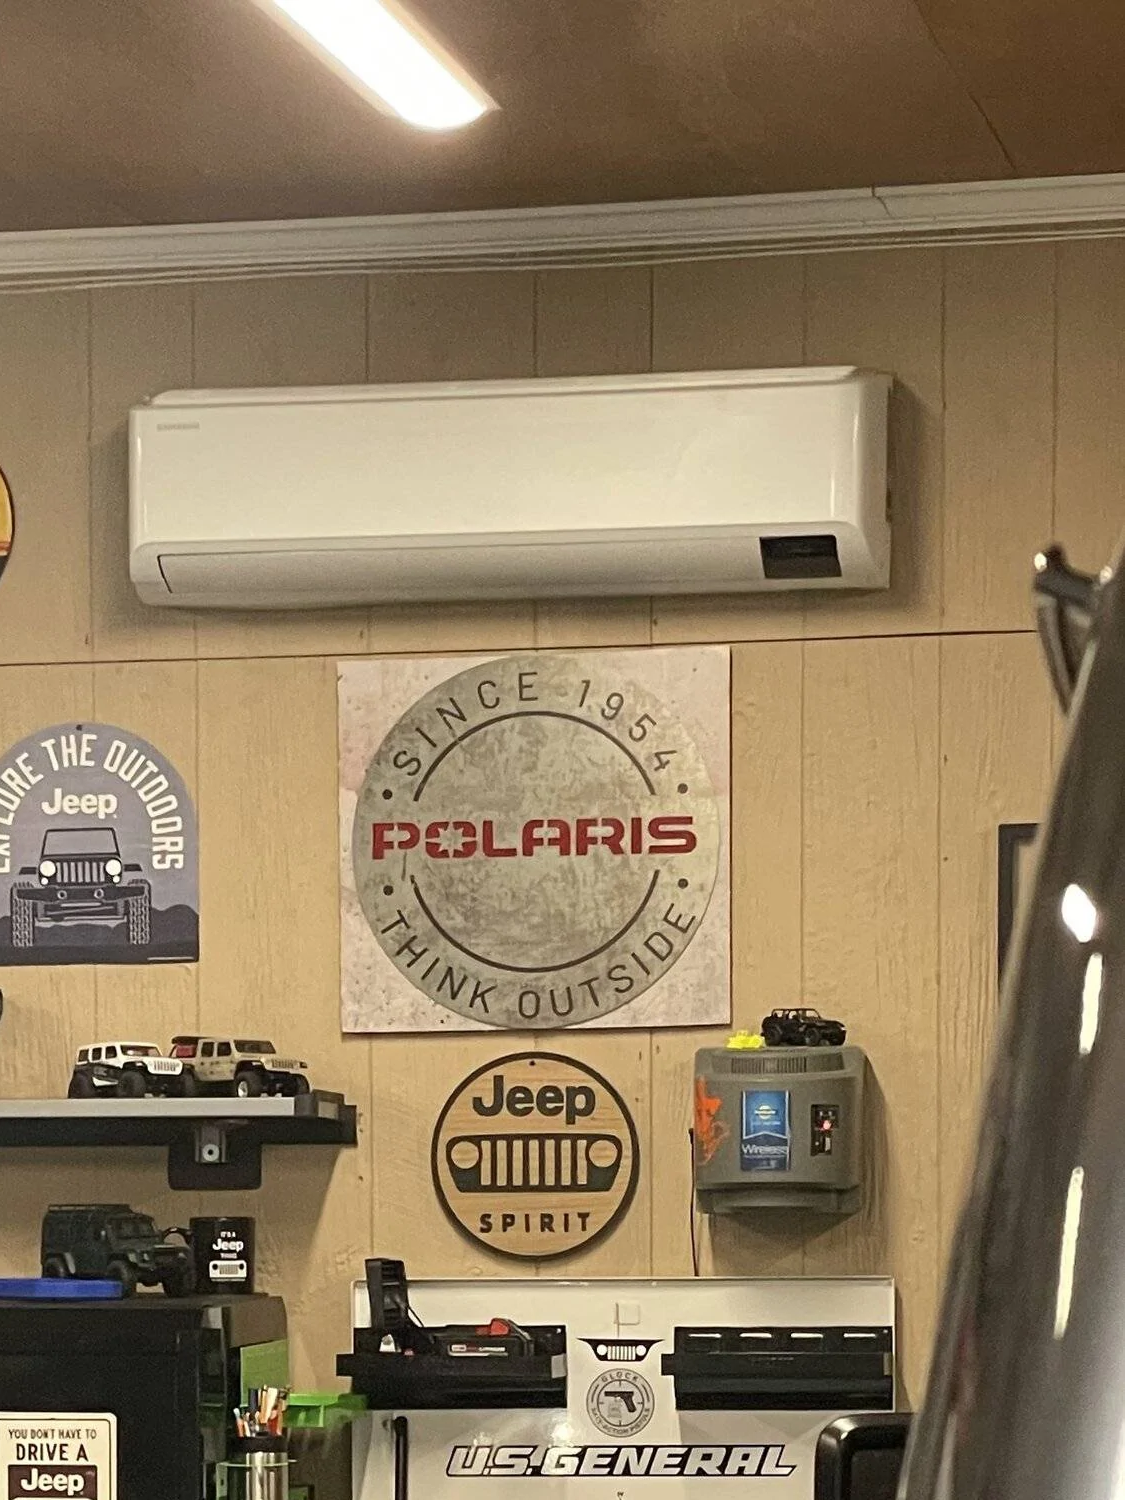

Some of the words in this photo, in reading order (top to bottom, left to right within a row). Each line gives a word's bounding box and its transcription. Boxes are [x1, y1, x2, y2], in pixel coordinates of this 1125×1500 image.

[393, 672, 539, 777] SINCE
[577, 680, 677, 772] 1954
[41, 733, 97, 771] THE
[103, 740, 184, 870] OUTDOORS
[41, 788, 118, 819] Jeep
[372, 816, 697, 860] POLARIS
[381, 910, 497, 1013] THINK
[518, 903, 695, 1020] OUTSIDE
[472, 1075, 596, 1125] Jeep
[479, 1212, 591, 1233] SPIRIT
[212, 1238, 244, 1253] Jeep
[601, 1371, 638, 1382] GLOCK
[8, 1428, 27, 1440] YOU
[30, 1428, 55, 1440] DON'T
[58, 1428, 81, 1440] HAVE
[85, 1428, 97, 1440] TO
[16, 1443, 69, 1461] DRIVE
[76, 1443, 89, 1462] A
[20, 1467, 85, 1496] Jeep
